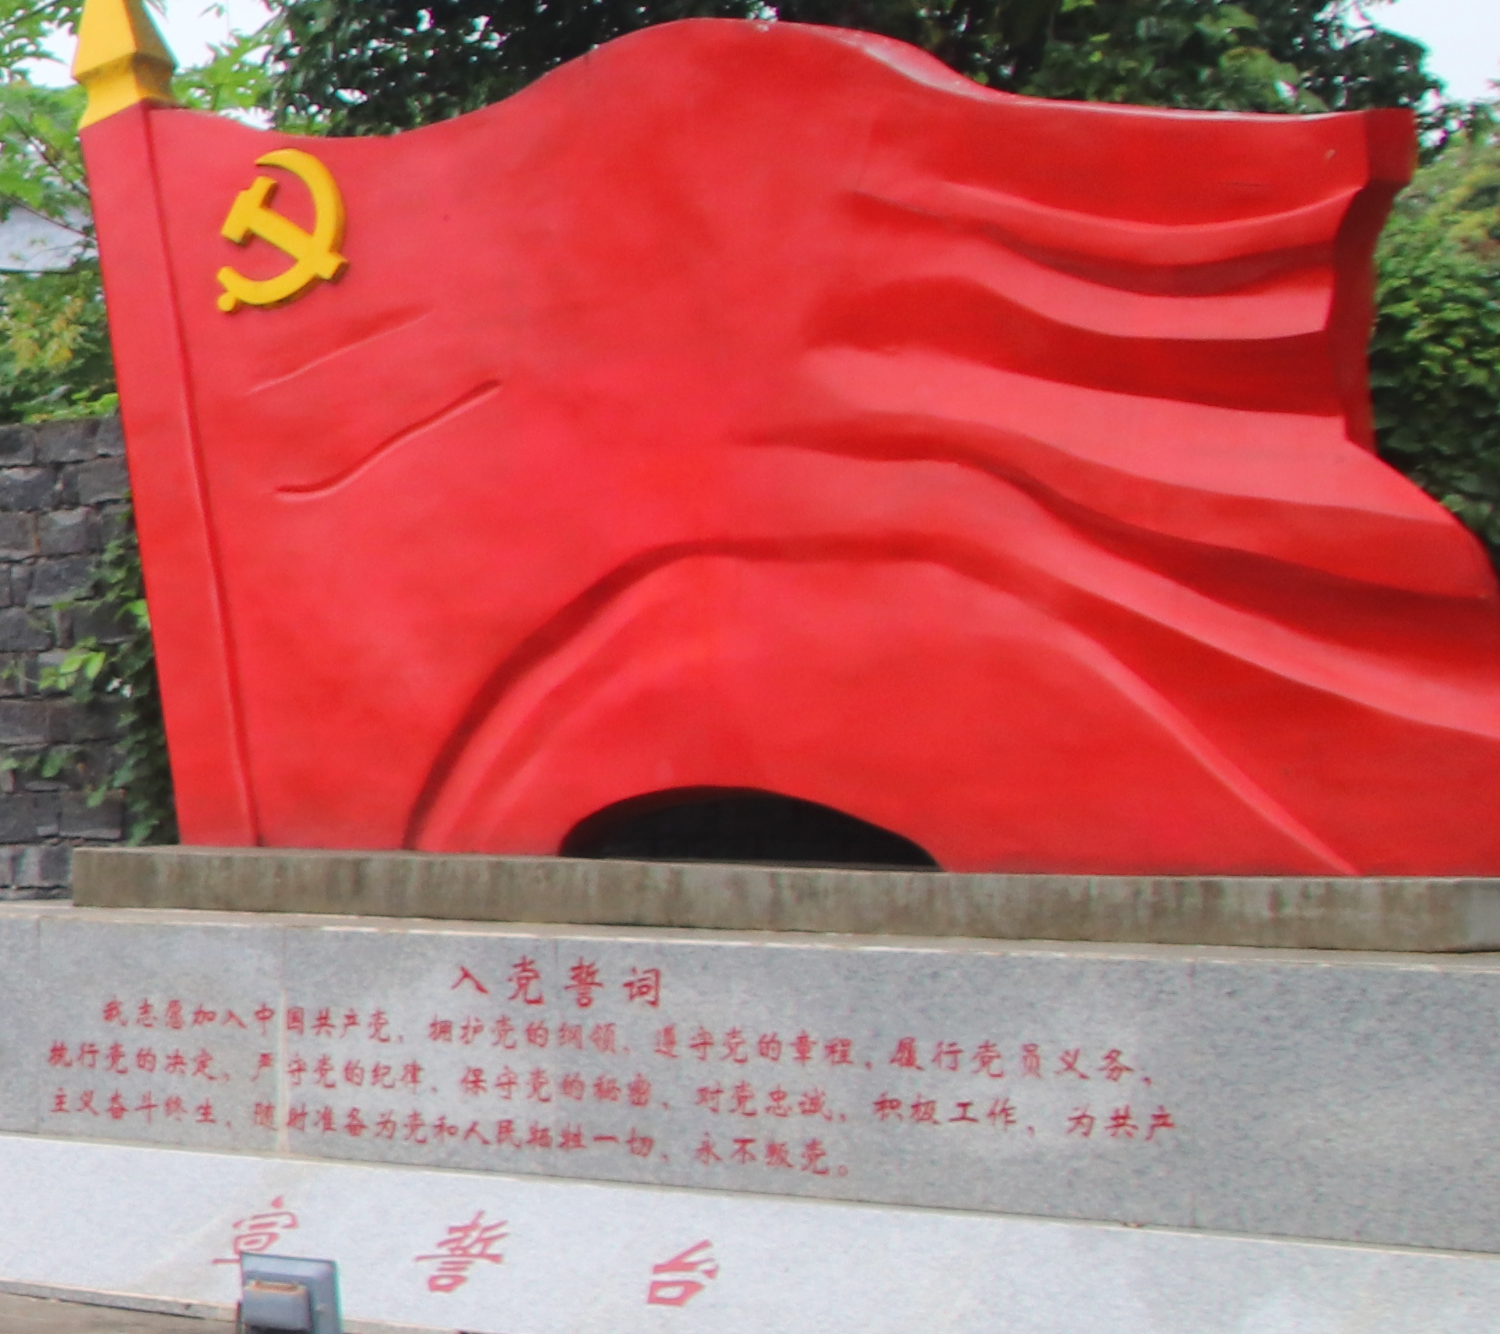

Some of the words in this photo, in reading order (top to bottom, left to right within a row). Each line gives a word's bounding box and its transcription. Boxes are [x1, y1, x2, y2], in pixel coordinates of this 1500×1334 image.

[451, 955, 661, 1008] 入党誓词
[212, 1195, 720, 1306] 宣誓台
